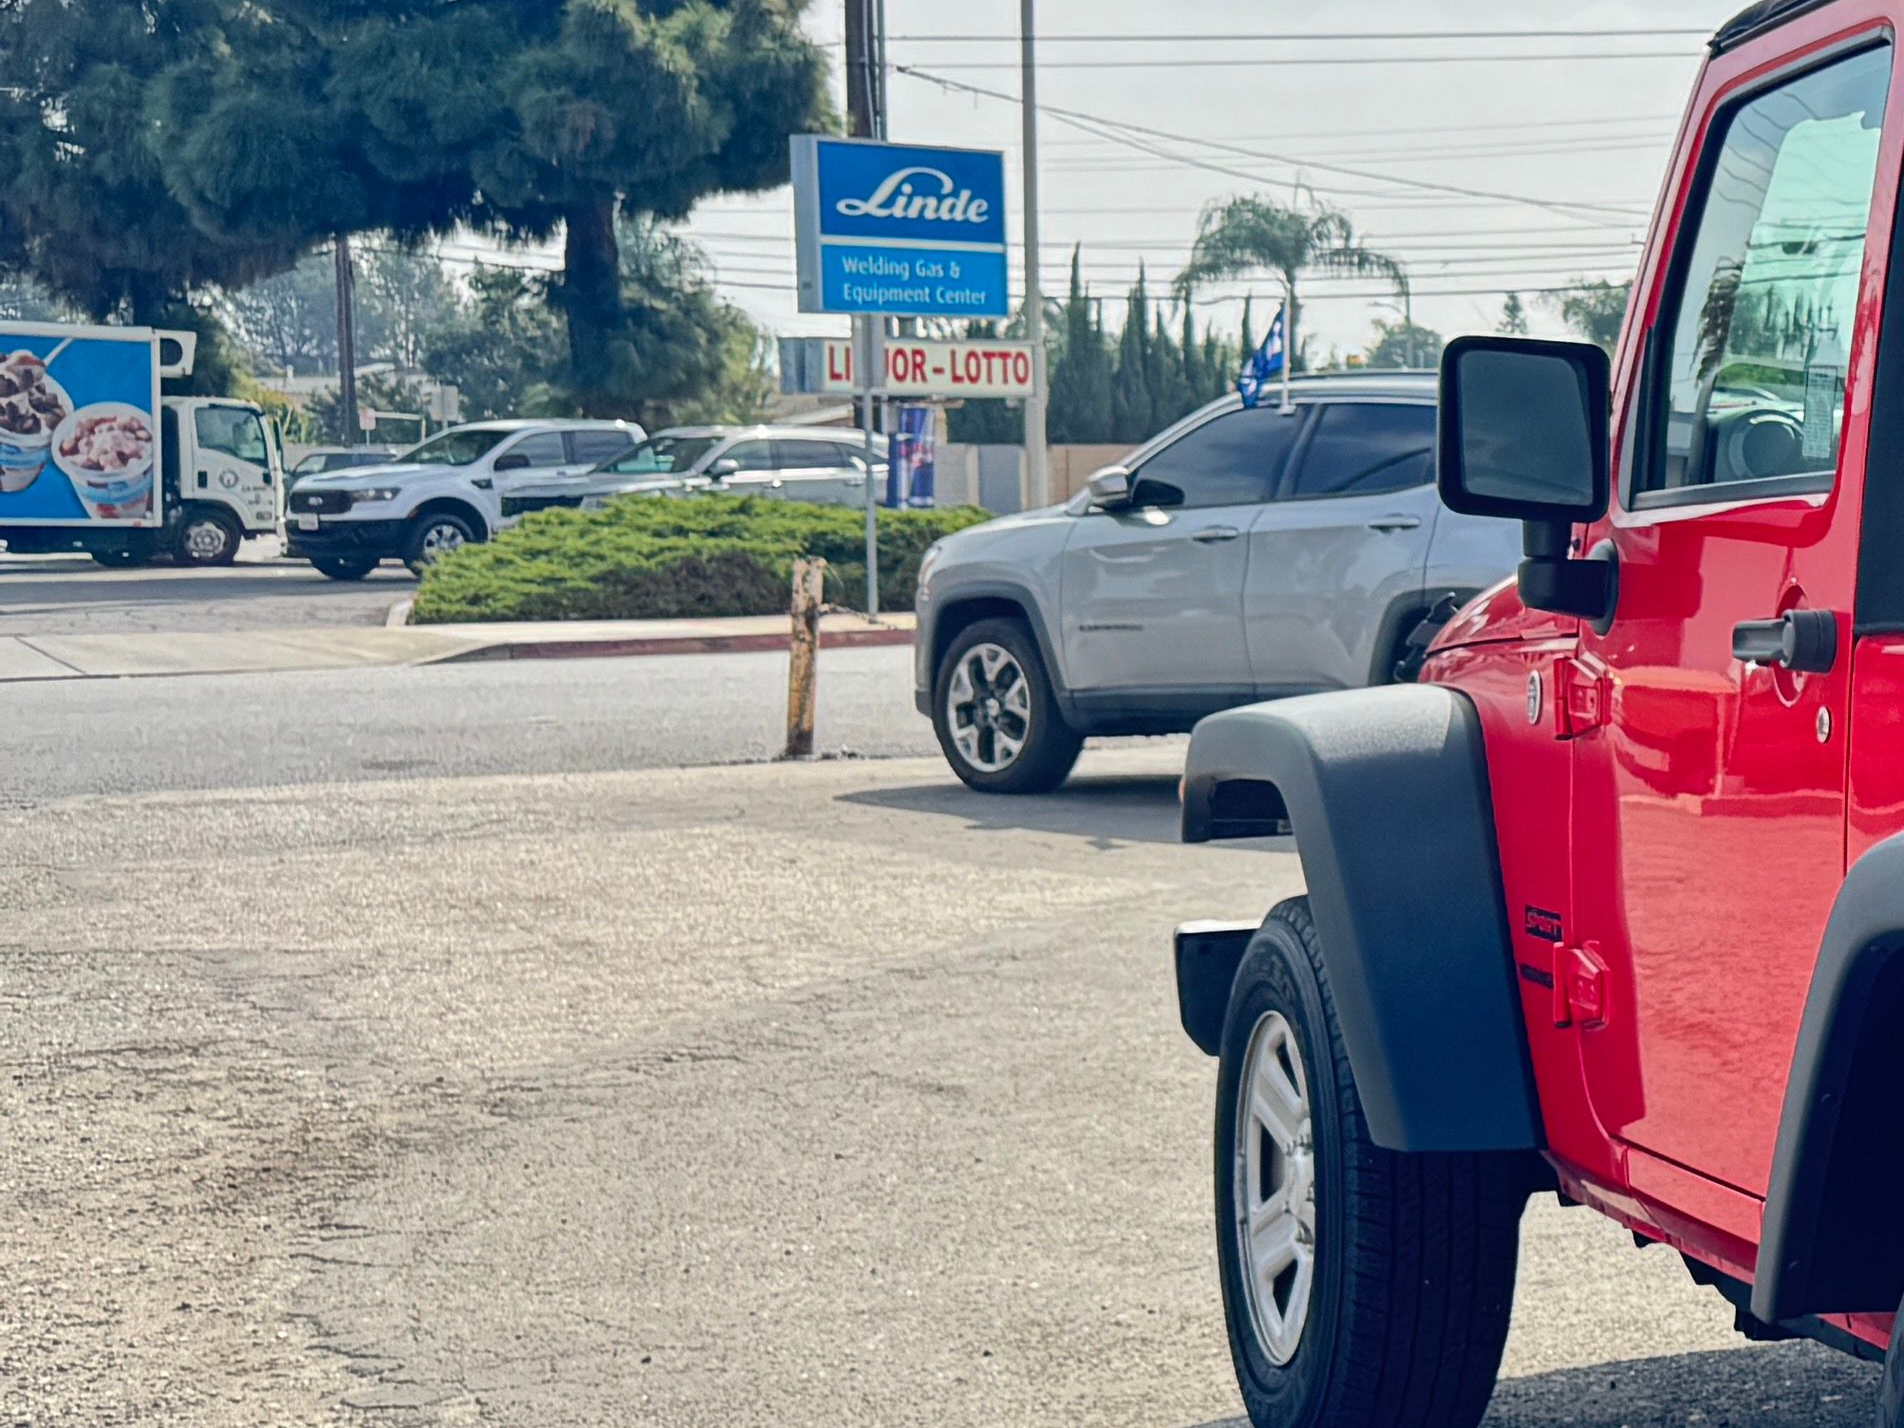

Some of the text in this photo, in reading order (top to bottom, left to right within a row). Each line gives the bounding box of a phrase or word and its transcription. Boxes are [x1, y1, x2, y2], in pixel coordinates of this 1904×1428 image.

[836, 166, 989, 223] Linde
[841, 255, 961, 281] Welding Gas &
[843, 283, 987, 305] Equipment Center
[828, 345, 927, 383] LIOR
[950, 348, 1029, 384] LOTTO
